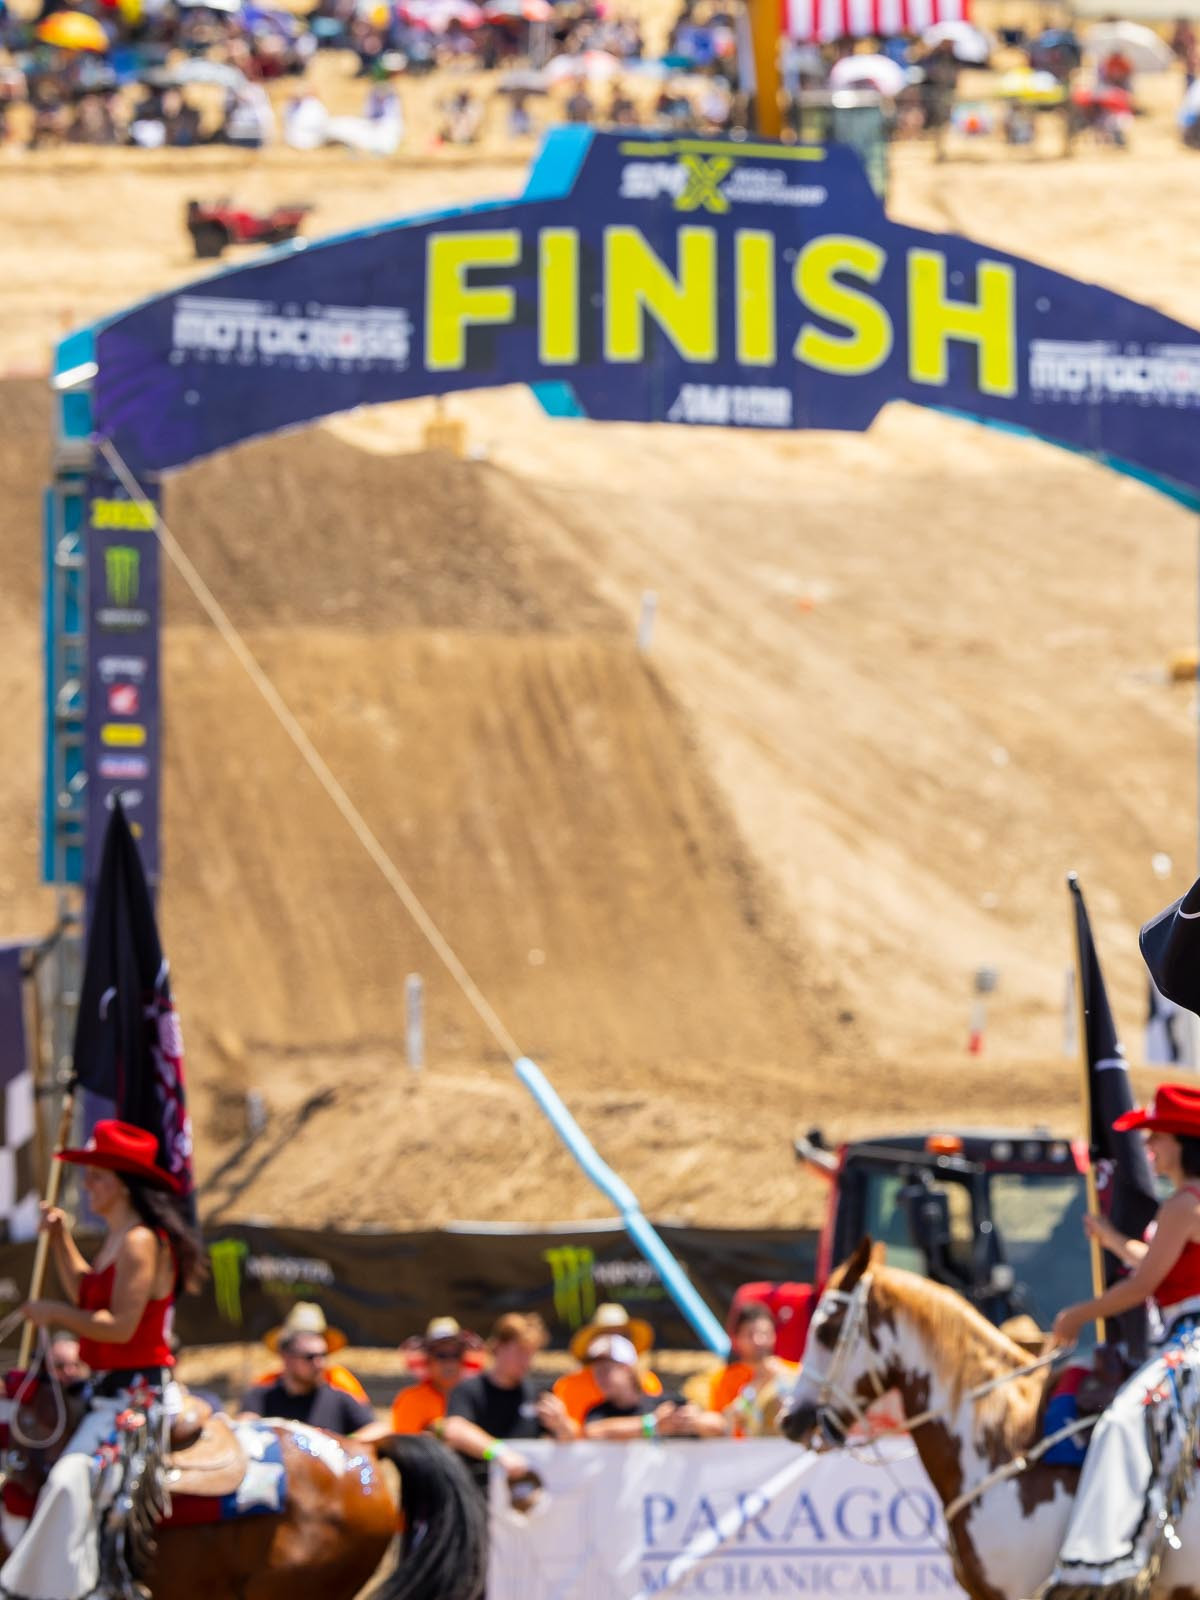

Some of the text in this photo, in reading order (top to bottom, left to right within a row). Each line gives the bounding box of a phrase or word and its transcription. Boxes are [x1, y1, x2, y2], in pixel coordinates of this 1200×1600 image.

[425, 225, 1018, 398] FINISH
[642, 1488, 938, 1545] PARAGO
[642, 1561, 902, 1597] MCHANICAL
